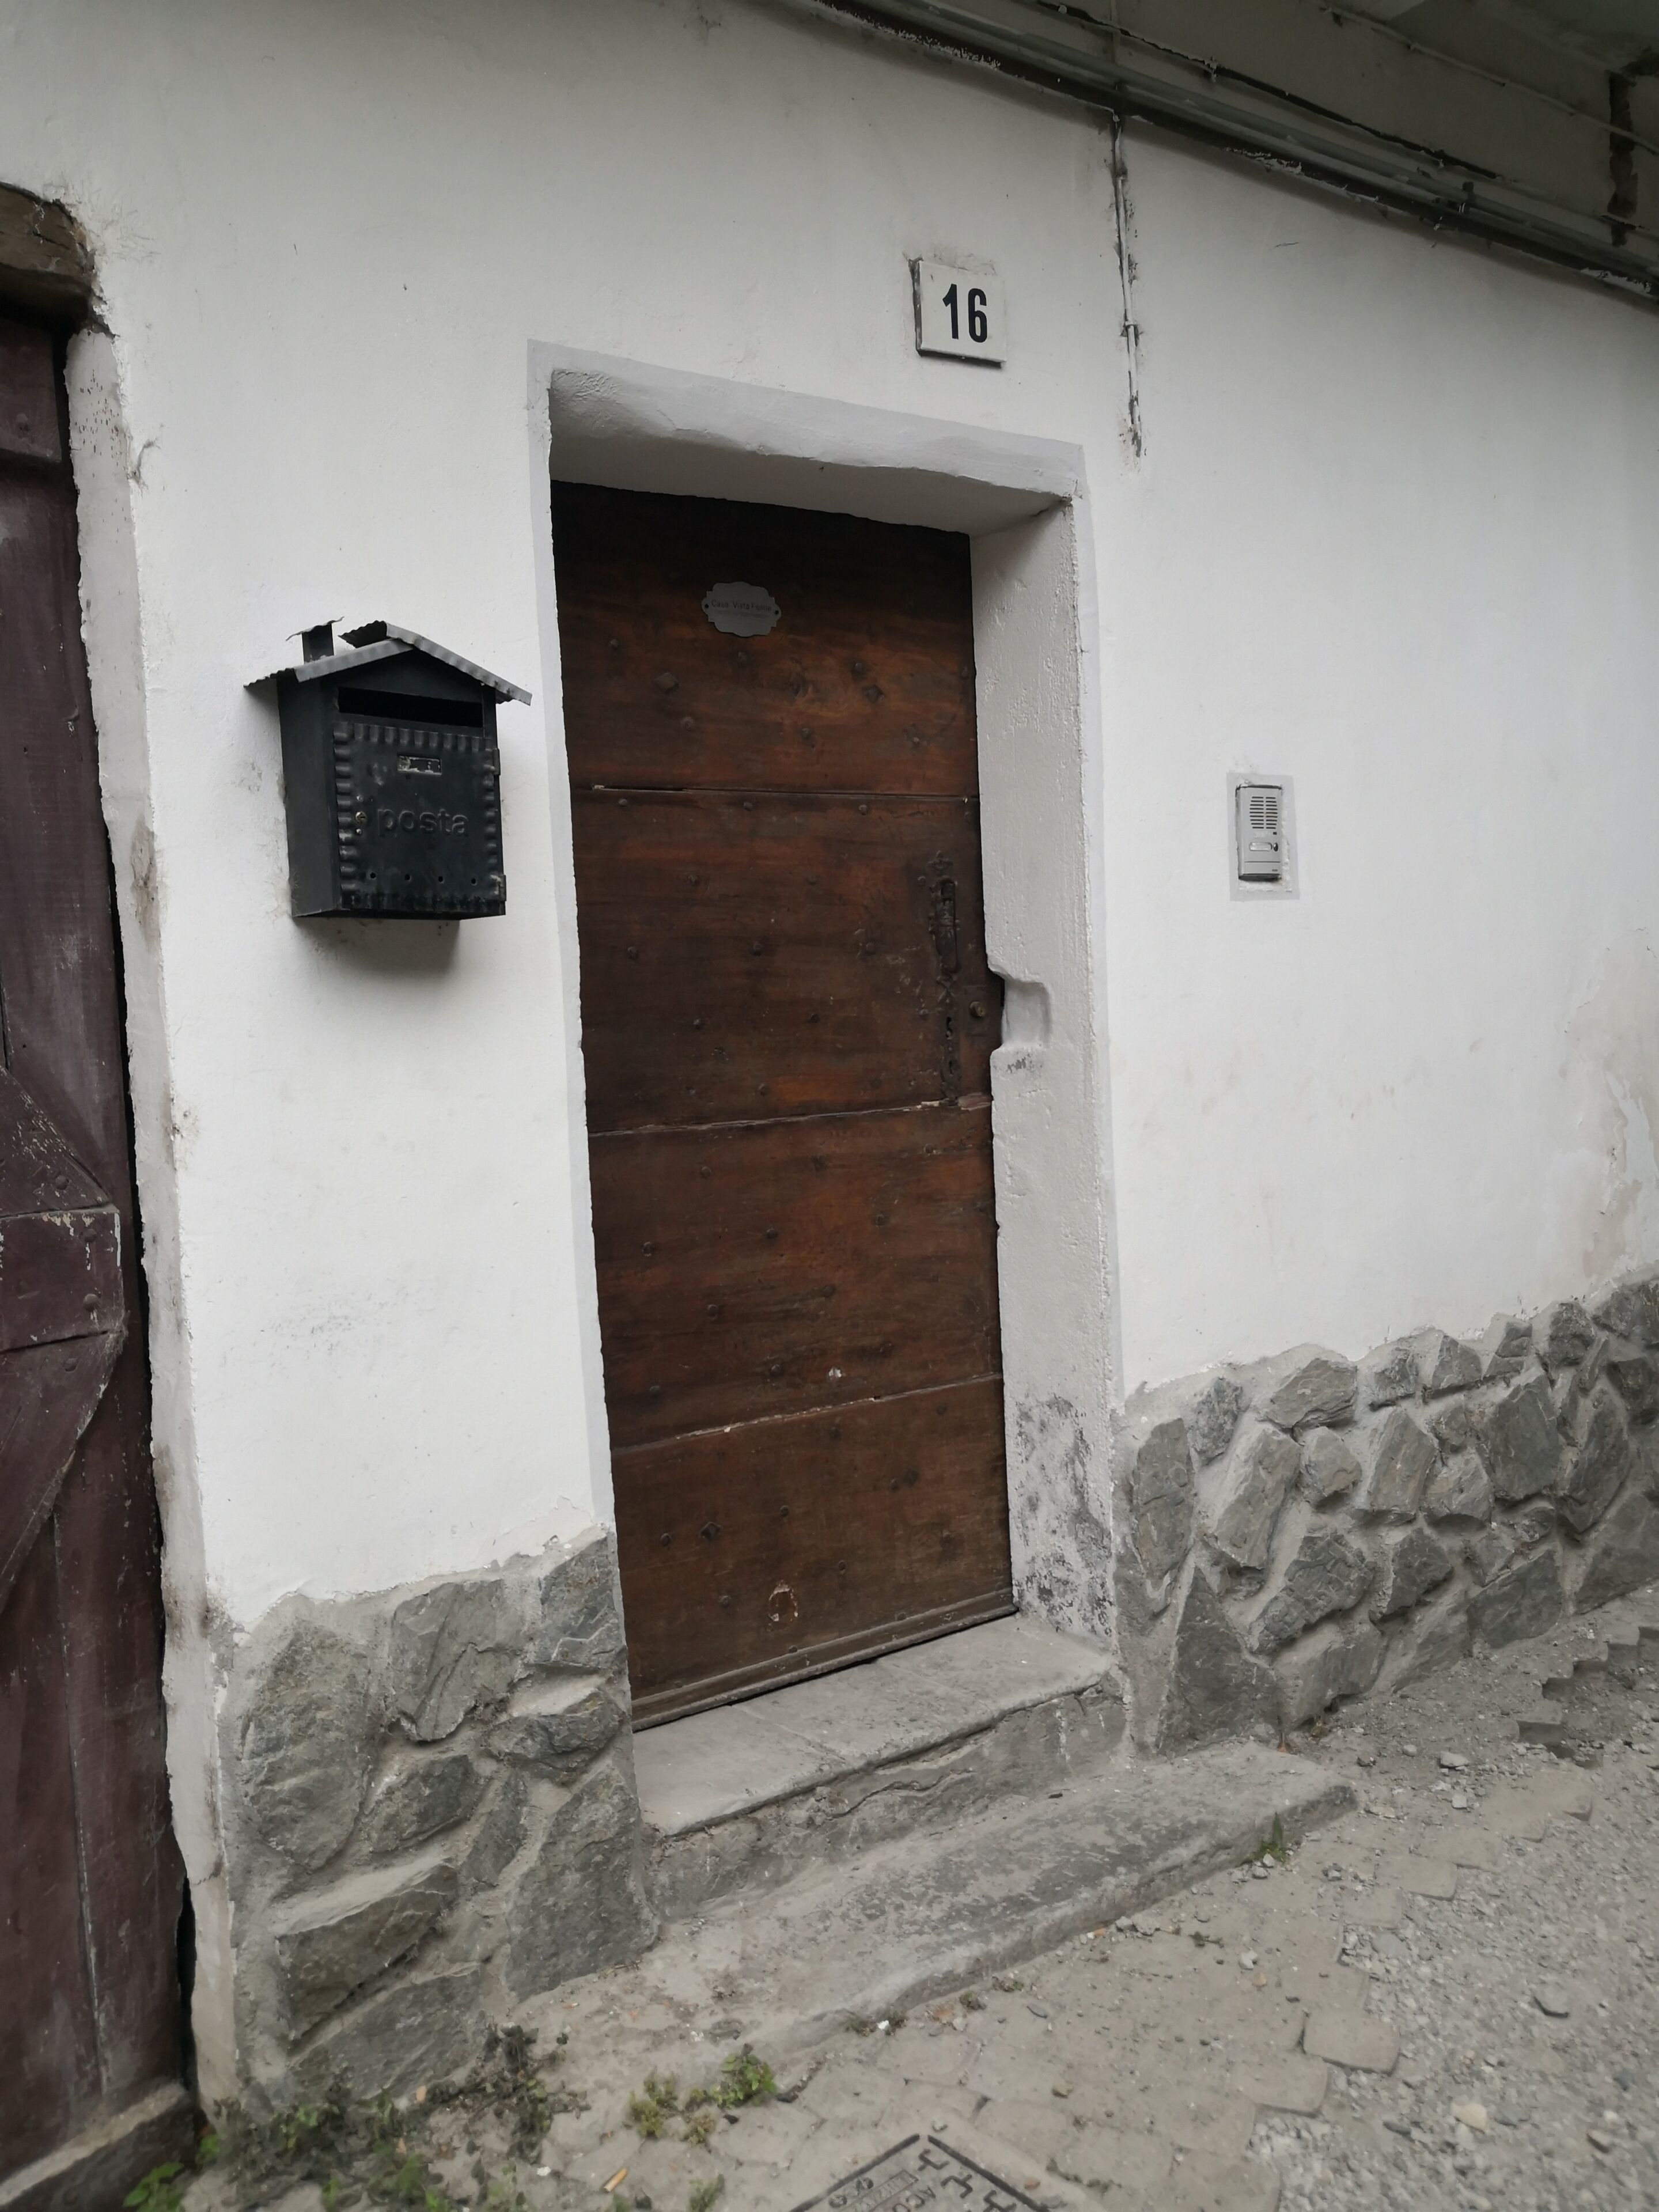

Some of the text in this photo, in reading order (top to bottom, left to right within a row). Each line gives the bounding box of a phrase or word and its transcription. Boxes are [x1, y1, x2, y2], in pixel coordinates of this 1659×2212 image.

[942, 283, 987, 343] 16
[732, 601, 749, 610] Vista
[377, 808, 468, 836] posta
